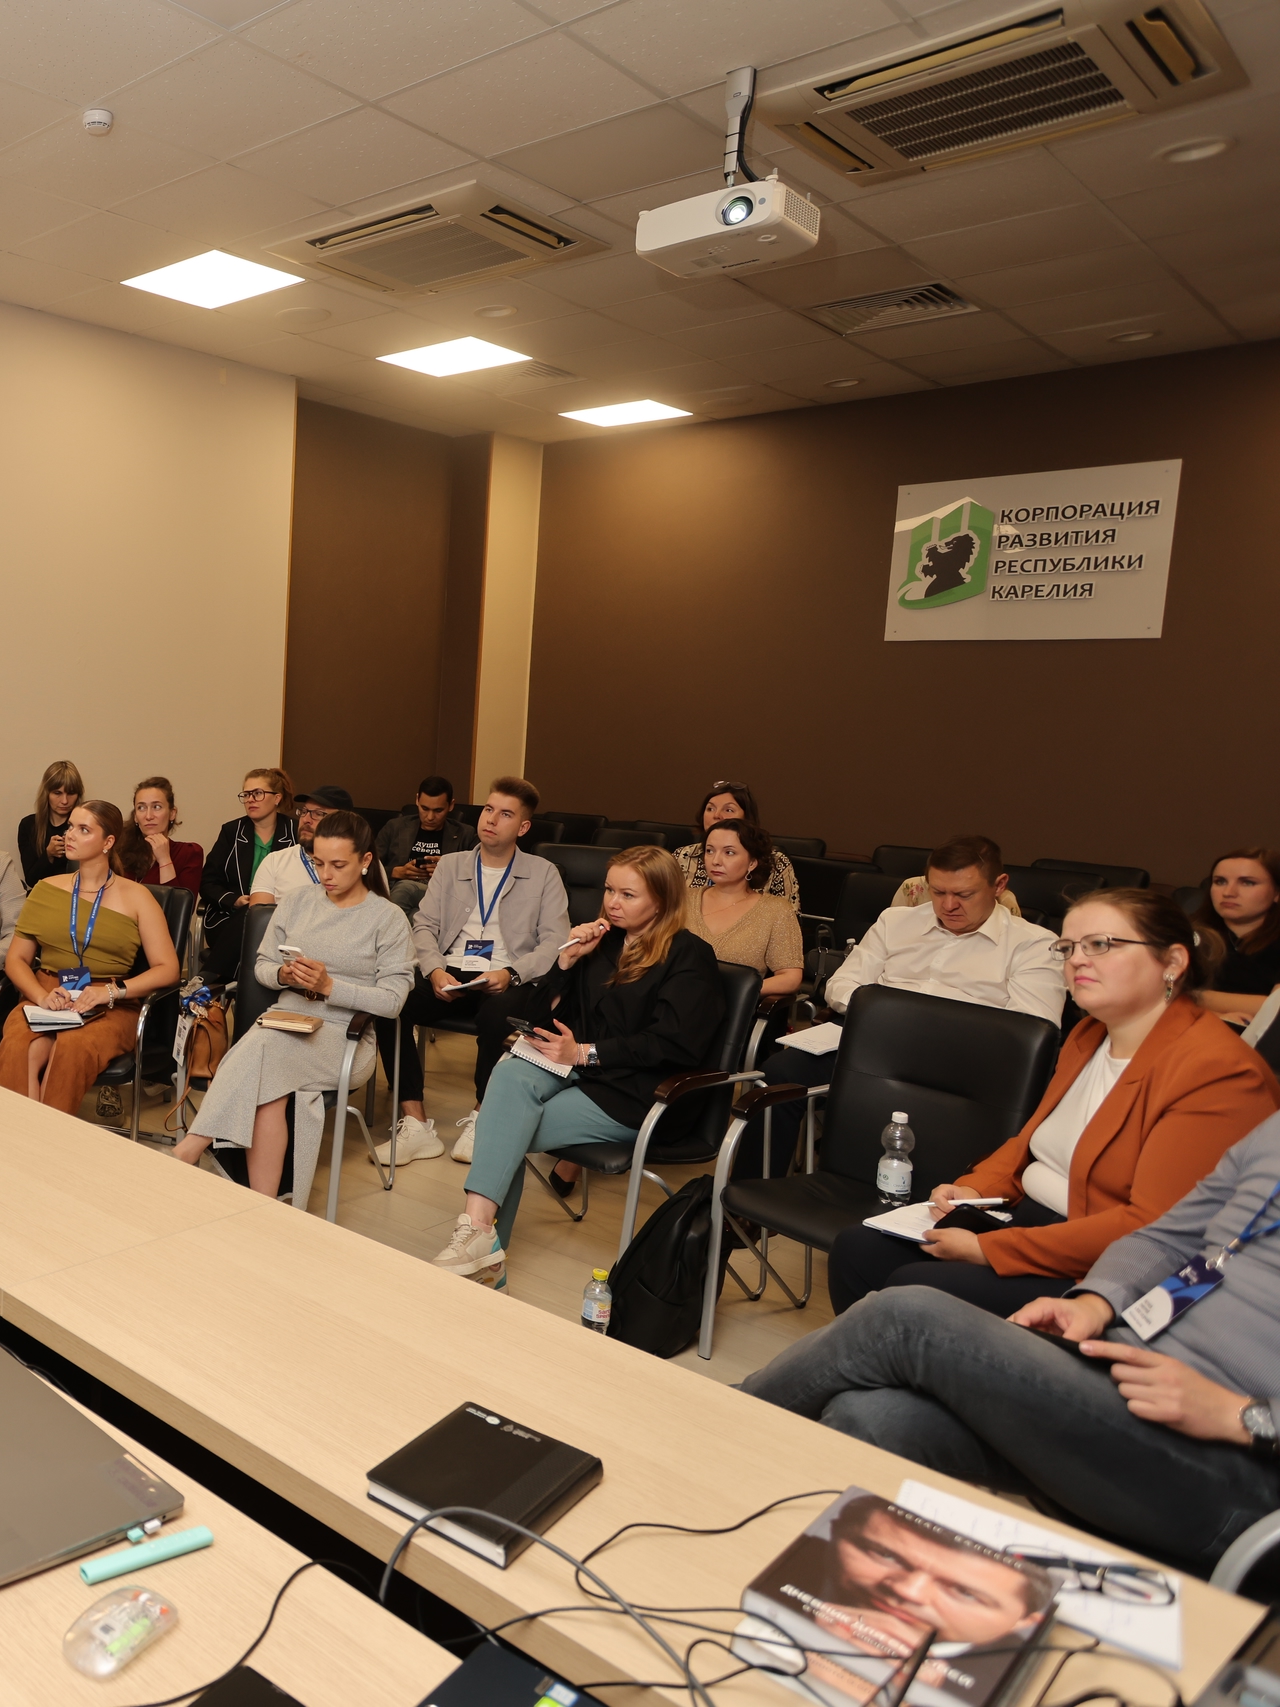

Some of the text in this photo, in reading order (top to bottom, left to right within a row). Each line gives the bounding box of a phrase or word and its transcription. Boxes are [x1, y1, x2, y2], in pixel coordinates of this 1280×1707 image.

[999, 499, 1161, 526] КОРПОРАЦИЯ
[996, 528, 1117, 550] РАЗВИТИЯ
[993, 554, 1144, 575] РЕСПУБЛИКИ
[990, 582, 1094, 600] КАРЕЛИЯ
